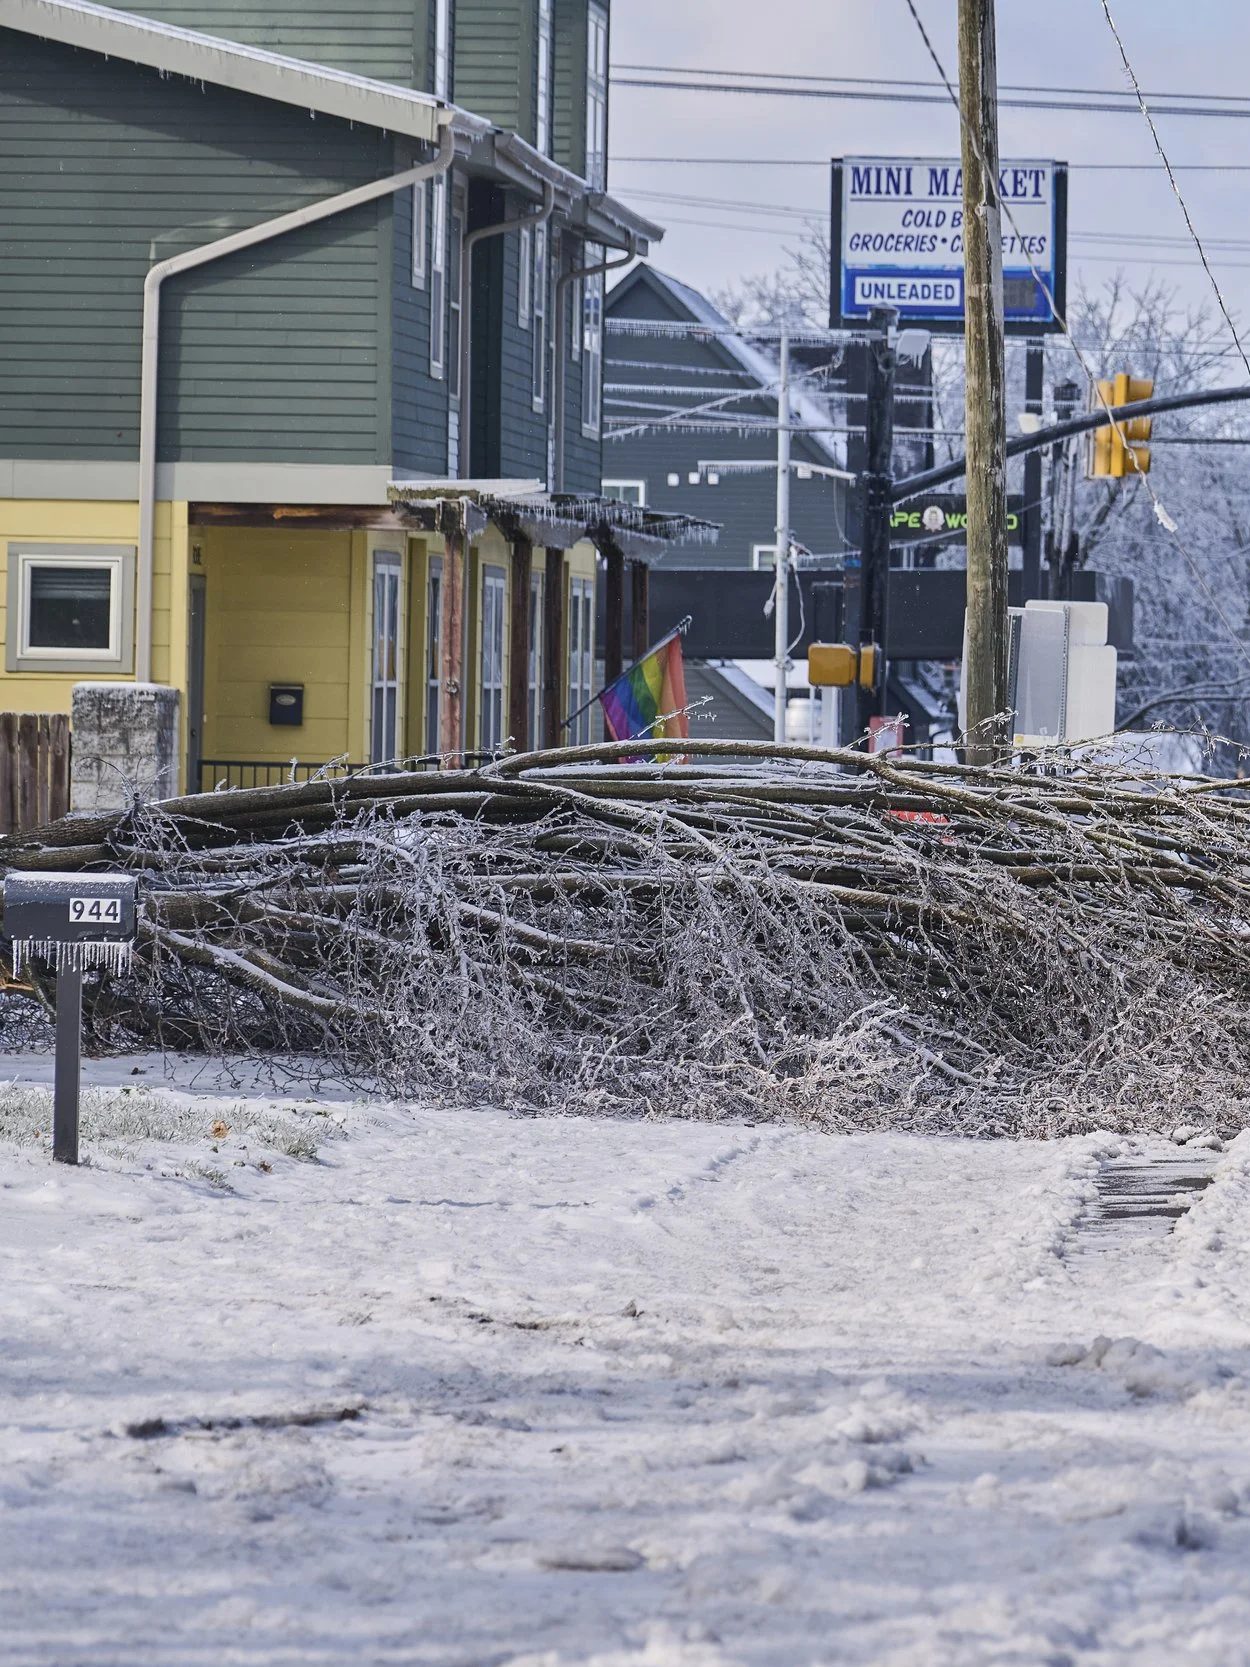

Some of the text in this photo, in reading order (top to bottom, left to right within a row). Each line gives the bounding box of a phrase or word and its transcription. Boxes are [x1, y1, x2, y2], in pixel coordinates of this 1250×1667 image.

[850, 166, 1046, 198] MINI MAKET
[901, 209, 946, 228] COLD
[849, 232, 938, 252] GROCERIES
[861, 283, 955, 300] UNLEADED
[72, 900, 119, 921] 944
